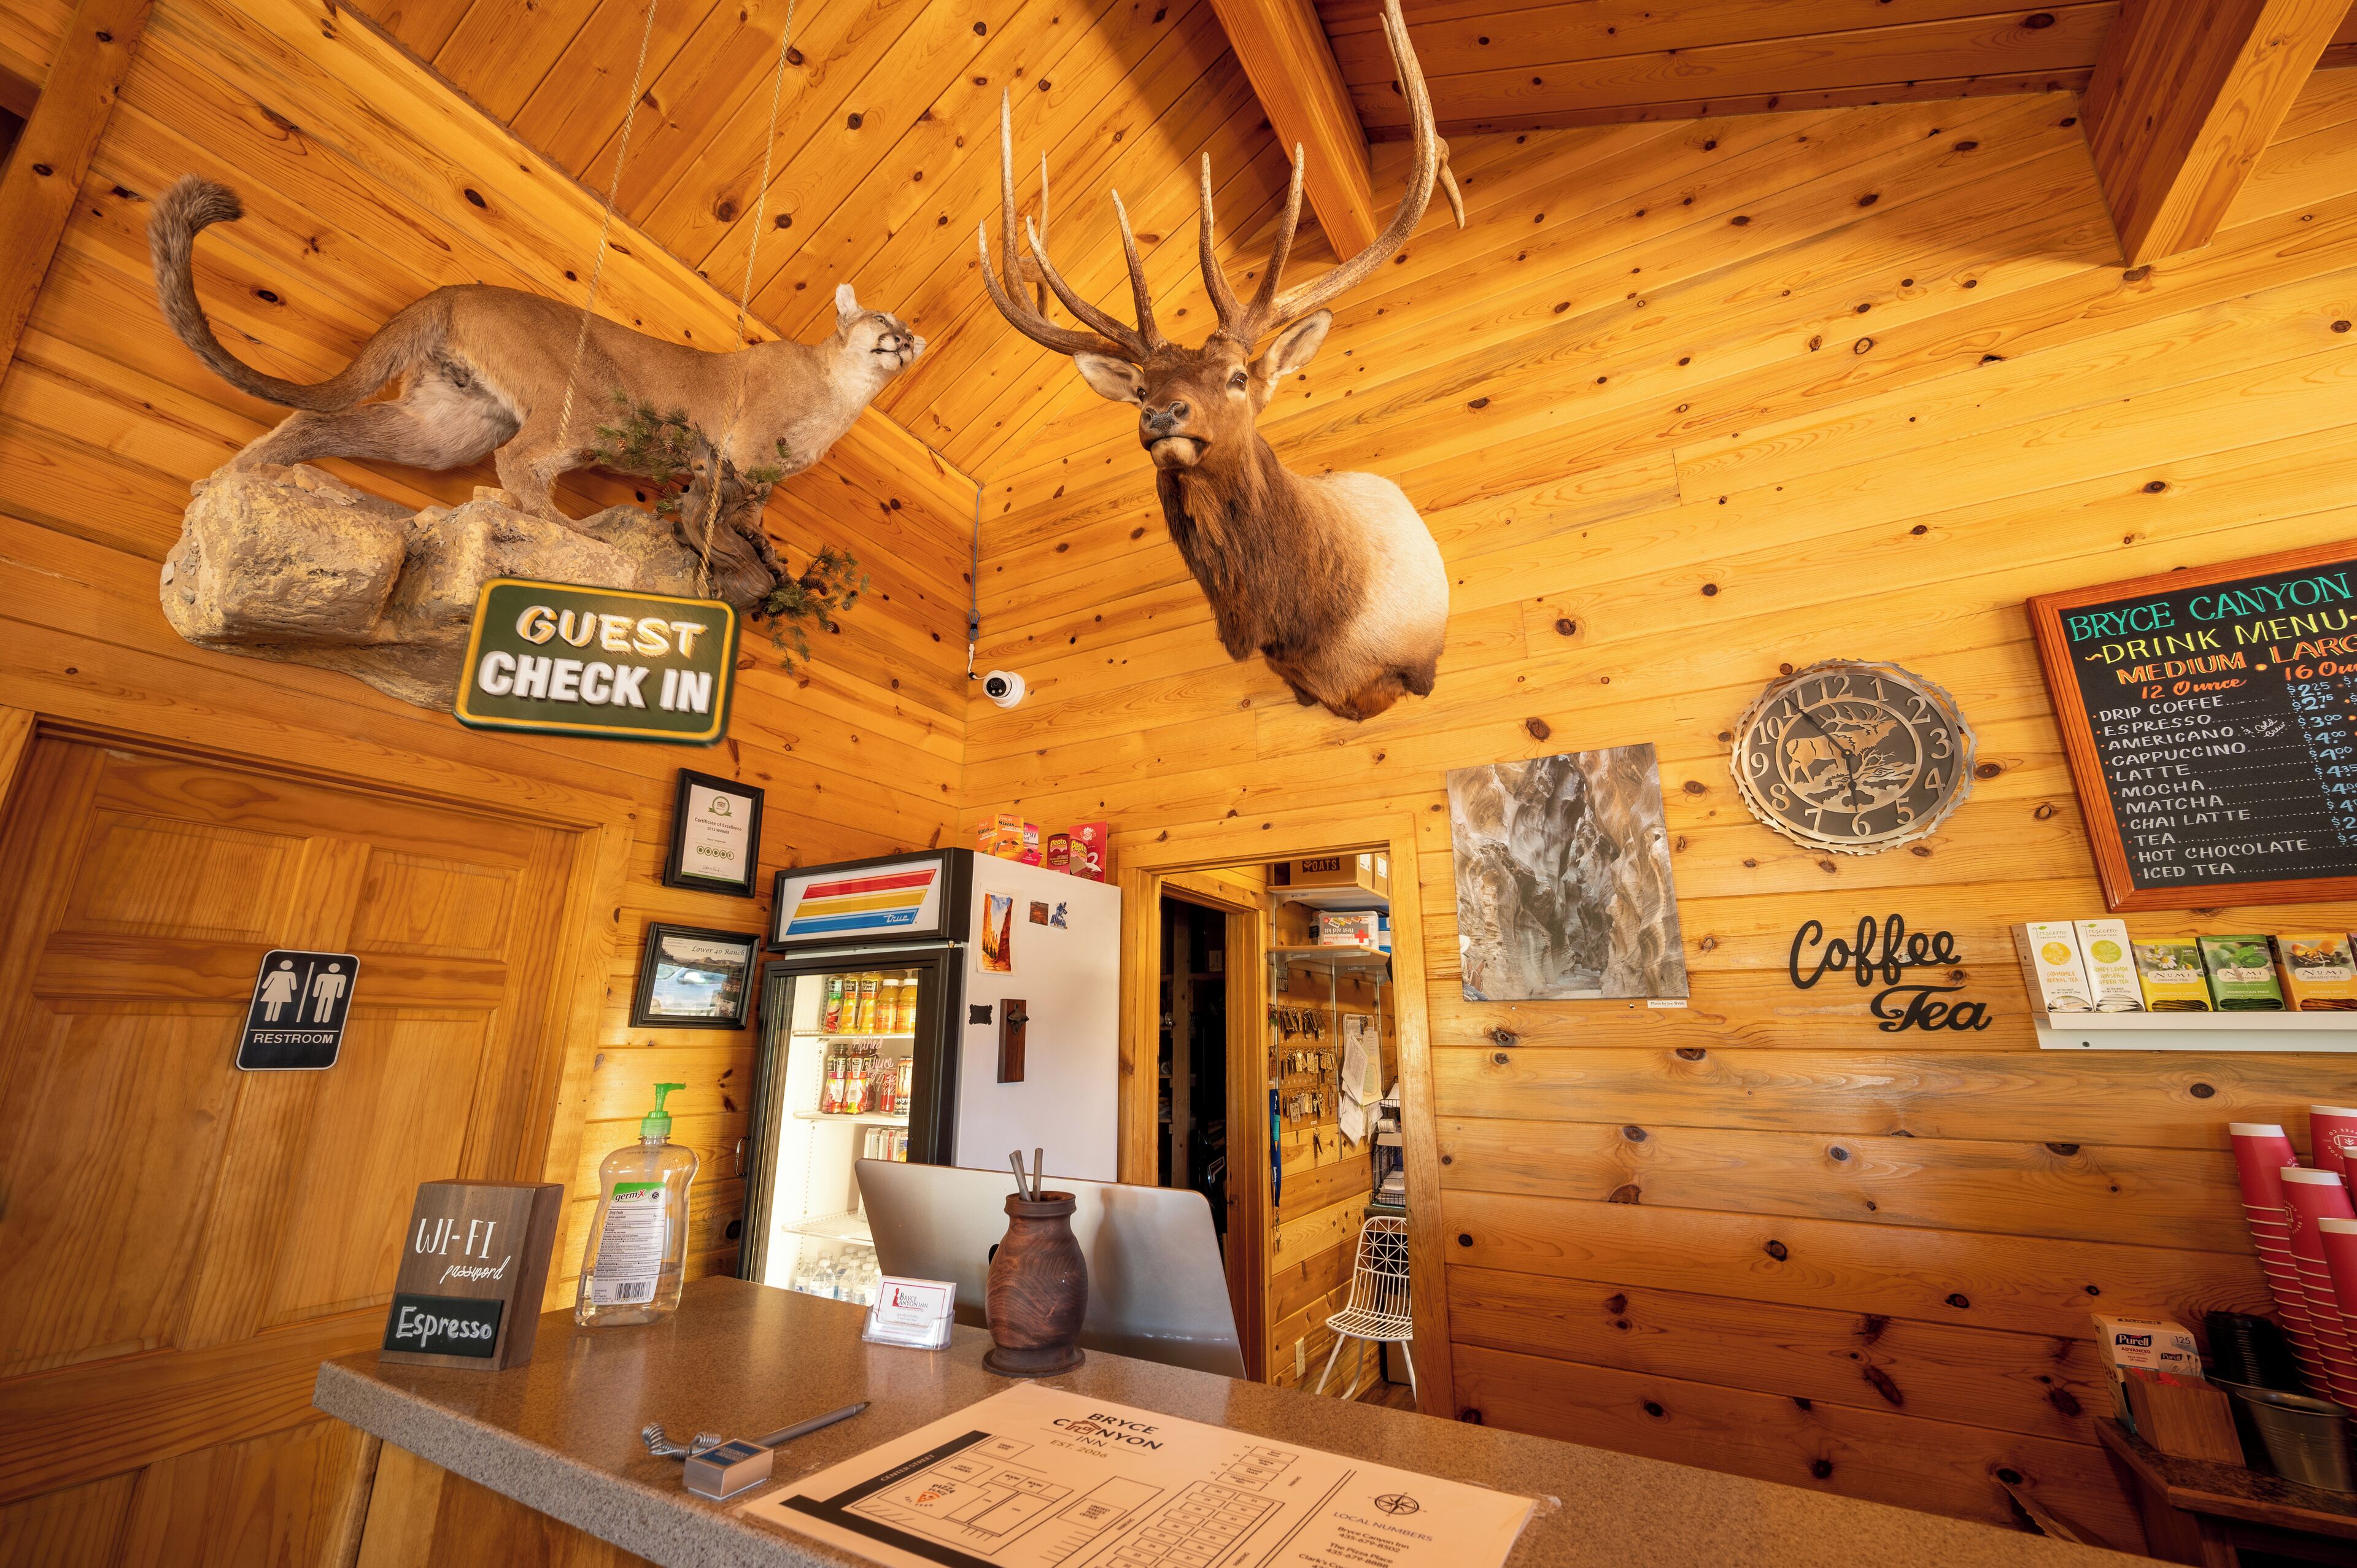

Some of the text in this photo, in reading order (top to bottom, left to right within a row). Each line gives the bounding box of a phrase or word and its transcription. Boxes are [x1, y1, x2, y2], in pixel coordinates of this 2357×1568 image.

[2067, 573, 2353, 641] BRYCE CANYON
[517, 605, 708, 658] GUEST
[2102, 609, 2347, 664] DRINK MENU
[2116, 651, 2248, 686] MEDIUM
[478, 651, 713, 714] CHECK IN
[1816, 675, 1852, 702] 12
[1870, 677, 1889, 701] 1
[2142, 684, 2165, 700] 12
[2173, 678, 2247, 696] Ounce
[2285, 665, 2313, 681] 16
[1779, 686, 1805, 719] 11
[1906, 696, 1930, 724] 2
[2099, 695, 2223, 722] DRIP COFFEE
[1755, 716, 1783, 745] 10
[2105, 714, 2212, 736] ESPRESSO
[2108, 727, 2234, 750] AMERICANO
[2255, 719, 2278, 732] Cold
[1929, 728, 1953, 759] 3
[2112, 742, 2246, 766] CAPPUCCINO
[1751, 752, 1768, 778] 9
[2116, 763, 2190, 782] LATTE
[1924, 767, 1945, 798] 4
[2121, 779, 2205, 798] MOCHA
[1770, 784, 1790, 811] 8
[1895, 797, 1914, 824] 5
[2126, 795, 2224, 814] MATCHA
[1805, 808, 1822, 832] 7
[1852, 812, 1870, 836] 6
[2131, 809, 2251, 830] CHAI LATTE
[2134, 833, 2176, 846] TEA
[2138, 839, 2311, 863] HOT CHOCOLATE
[2143, 862, 2236, 879] ICED TEA
[1789, 914, 1962, 989] Coffee
[1870, 985, 1992, 1032] Tea
[254, 1033, 334, 1044] RESTROOM
[415, 1218, 497, 1259] WI-FI
[439, 1256, 511, 1284] password
[900, 1292, 917, 1302] BRYCE
[395, 1306, 492, 1348] Espresso
[2119, 1334, 2191, 1346] Purell 125
[1087, 1413, 1159, 1434] BRYCE
[1050, 1440, 1109, 1458] EST. 2006
[1075, 1436, 1107, 1447] INN
[932, 1483, 956, 1494] PIZZA
[1333, 1512, 1433, 1542] LOCAL NUMBERS
[1337, 1526, 1361, 1536] Bryce
[1362, 1533, 1395, 1545] Canyon
[1339, 1533, 1401, 1553] 435-679-8502
[1346, 1547, 1368, 1557] Pizza
[1370, 1554, 1393, 1564] Place
